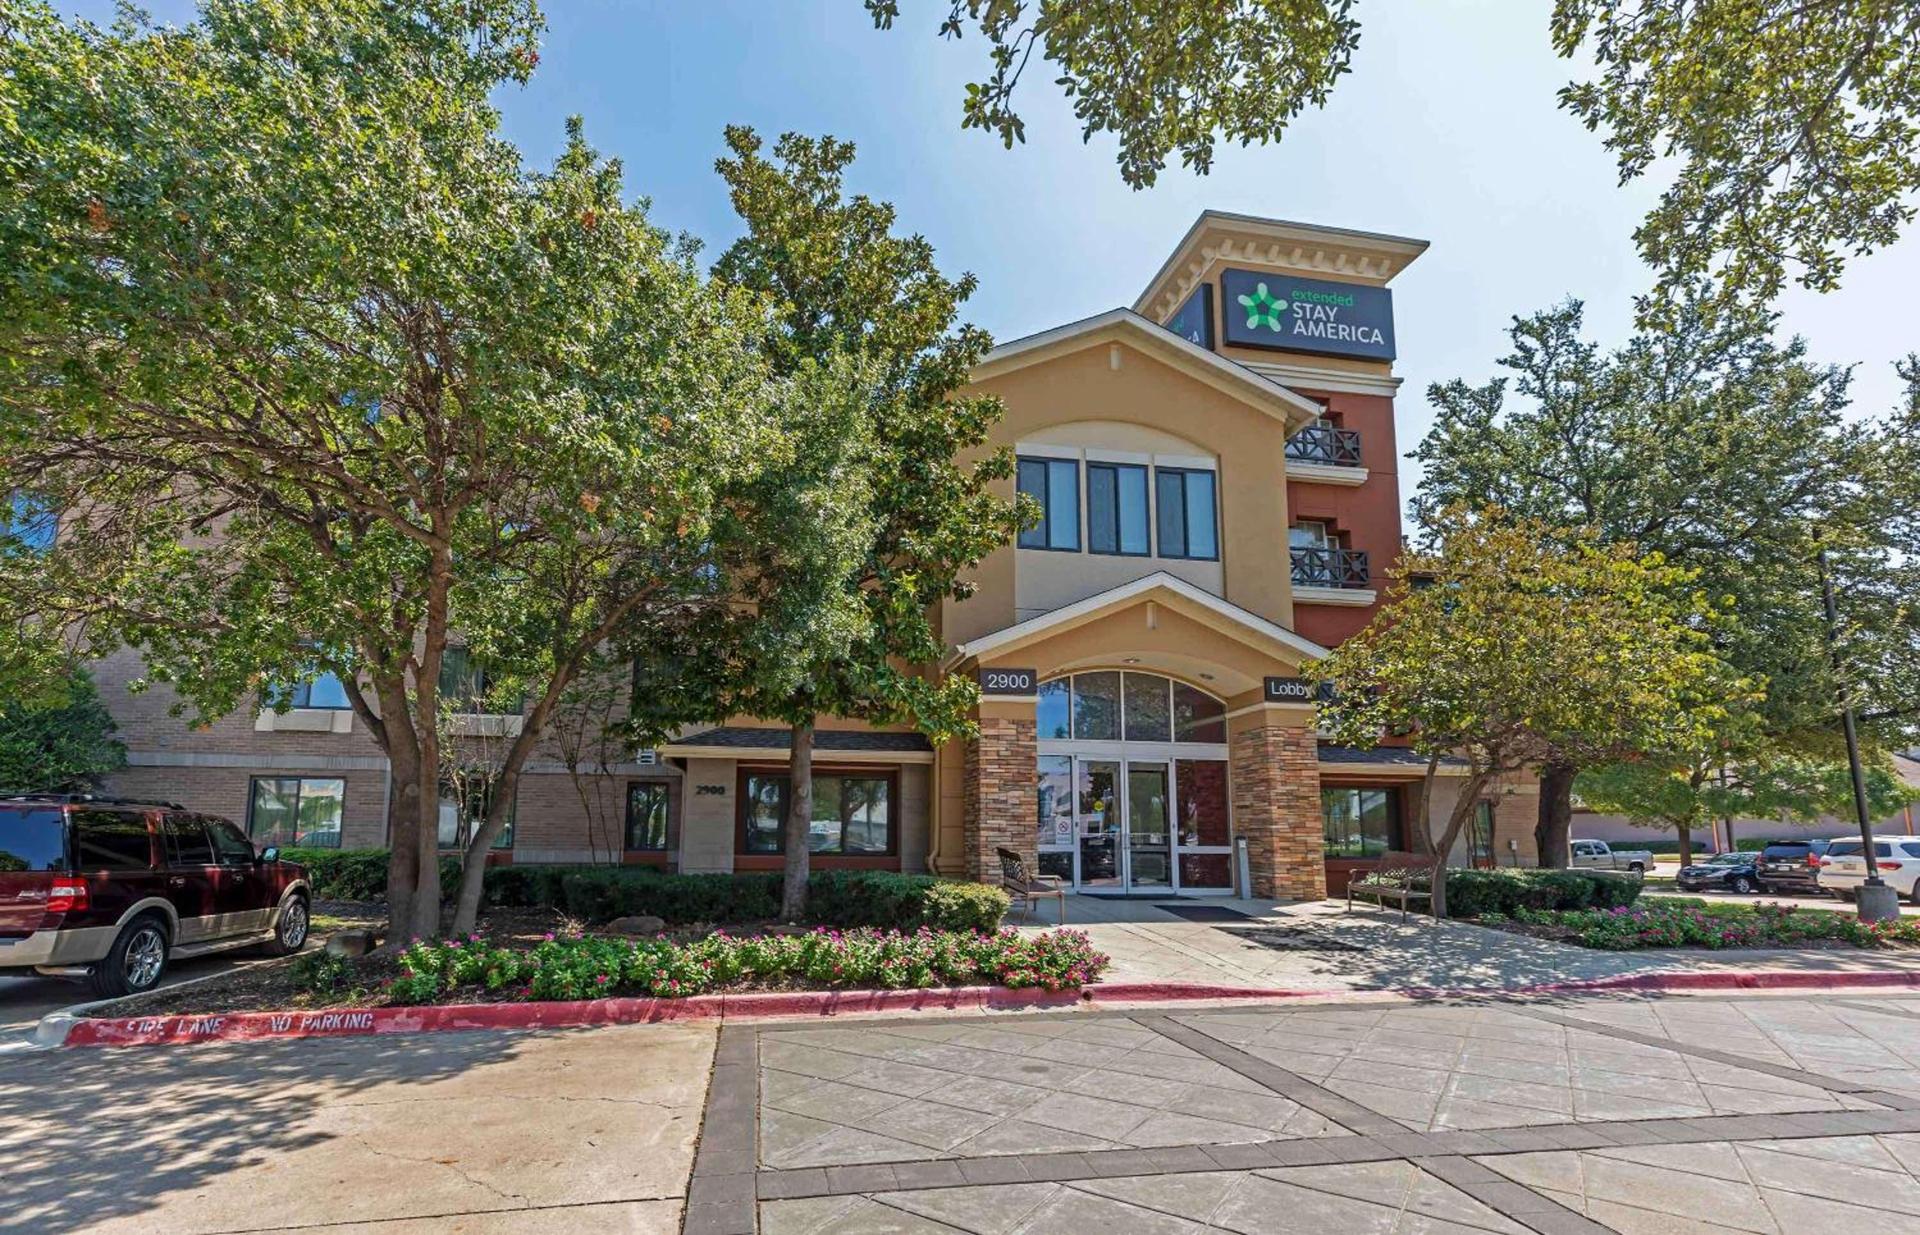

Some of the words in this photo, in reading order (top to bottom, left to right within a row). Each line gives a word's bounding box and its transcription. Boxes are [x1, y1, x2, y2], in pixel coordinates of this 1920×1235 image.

[1291, 289, 1353, 306] extended
[1292, 301, 1338, 322] STAY
[1293, 319, 1385, 345] AMERICA
[988, 674, 1029, 688] 2900
[1271, 681, 1314, 699] Lobby
[695, 784, 726, 796] 2900
[176, 1017, 225, 1035] LANE
[271, 1015, 292, 1032] NO
[300, 1013, 373, 1031] PARKING
